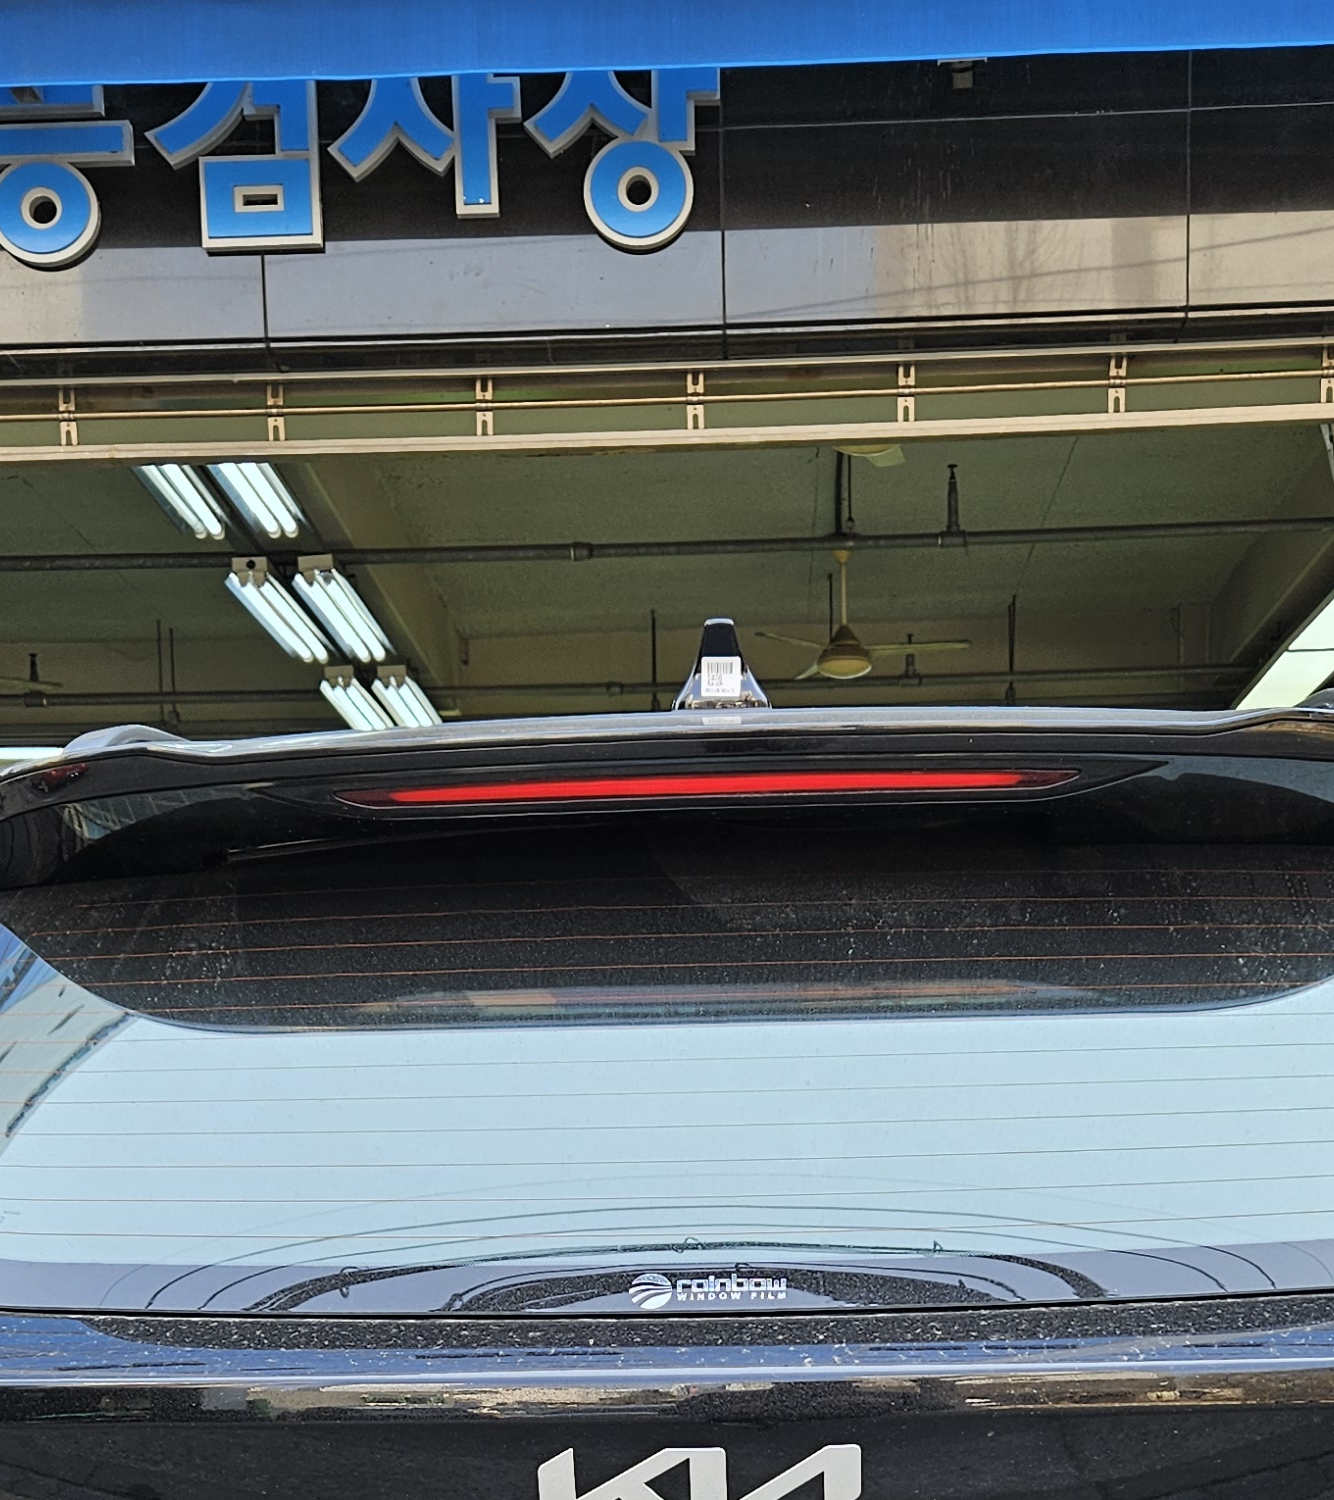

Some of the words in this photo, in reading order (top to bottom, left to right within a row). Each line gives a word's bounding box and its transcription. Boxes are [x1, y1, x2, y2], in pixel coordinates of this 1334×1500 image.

[676, 1273, 787, 1291] rainbow
[677, 1291, 741, 1302] WINDOW
[751, 1290, 787, 1300] FILM
